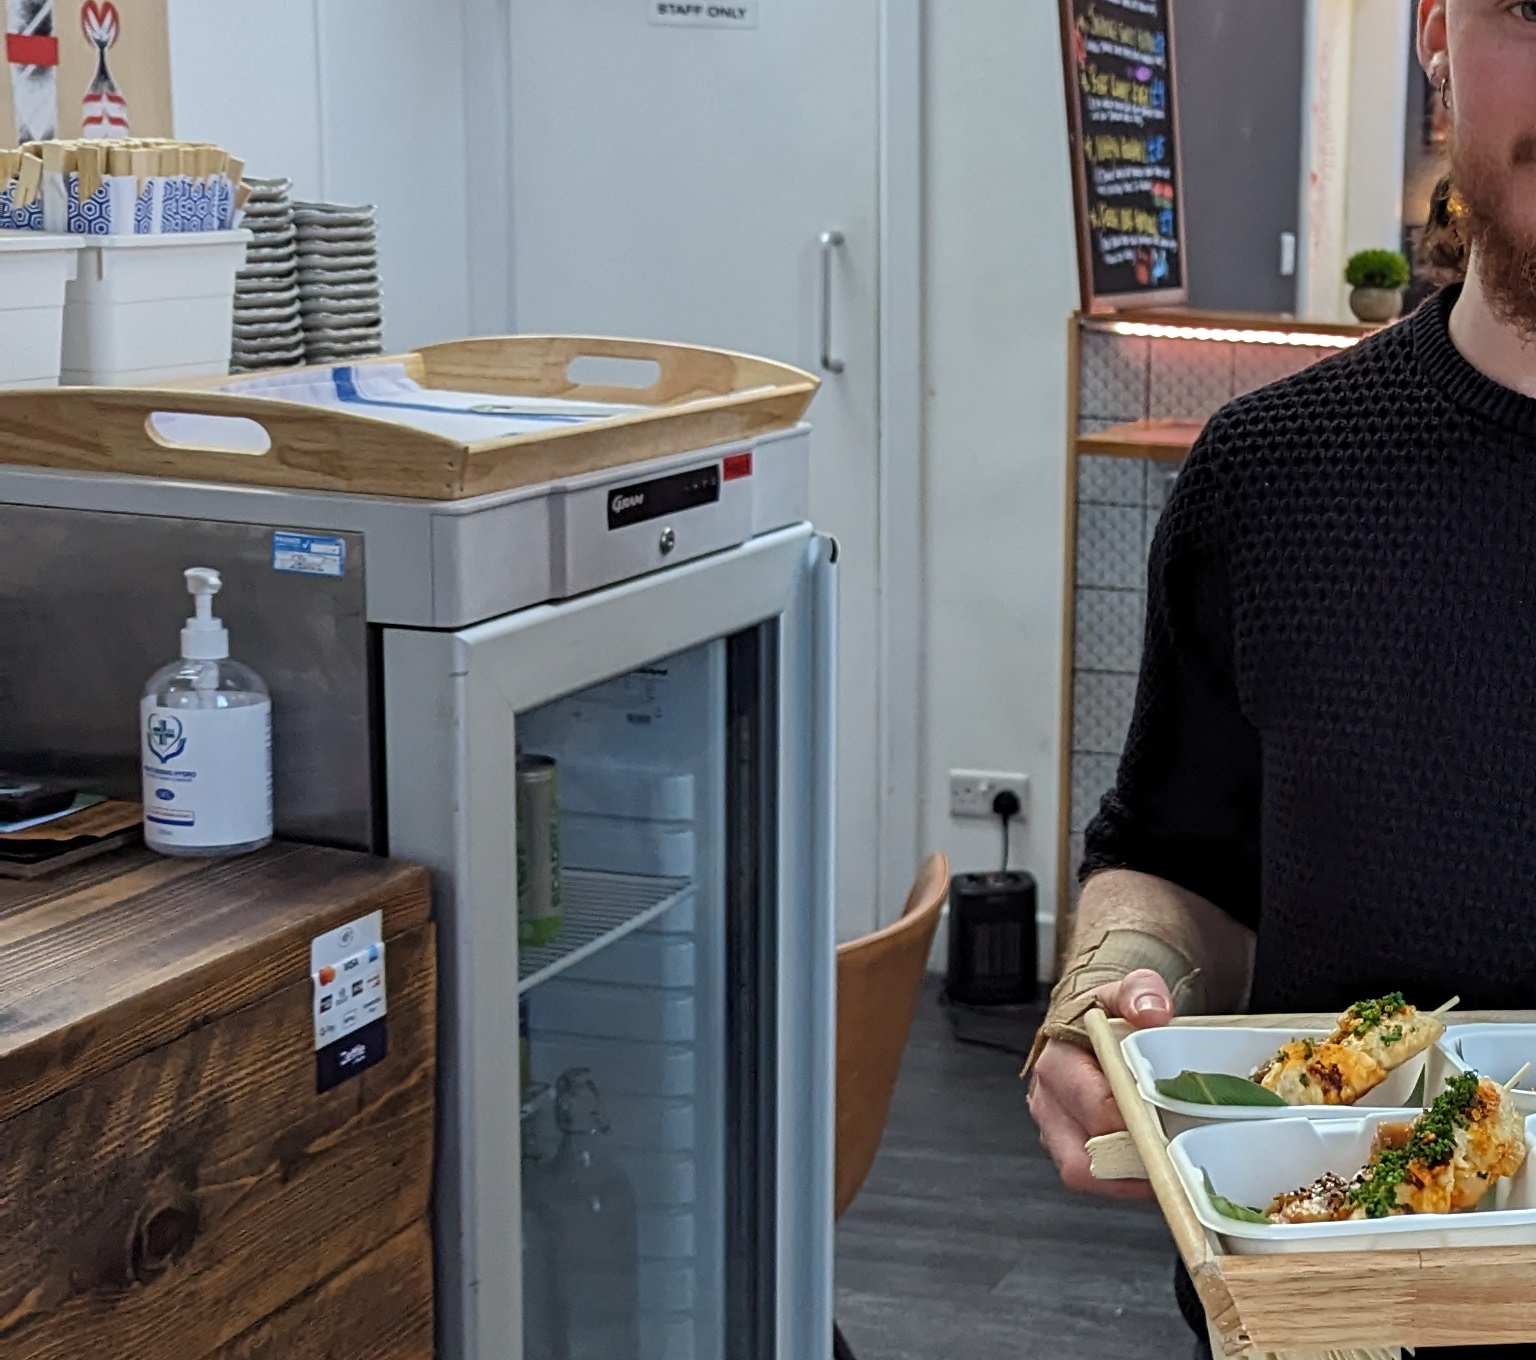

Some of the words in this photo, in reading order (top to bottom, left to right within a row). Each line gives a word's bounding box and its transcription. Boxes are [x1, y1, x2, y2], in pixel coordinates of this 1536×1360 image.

[656, 3, 702, 16] STAFF
[706, 6, 748, 19] ONLY
[611, 493, 645, 514] GRAM
